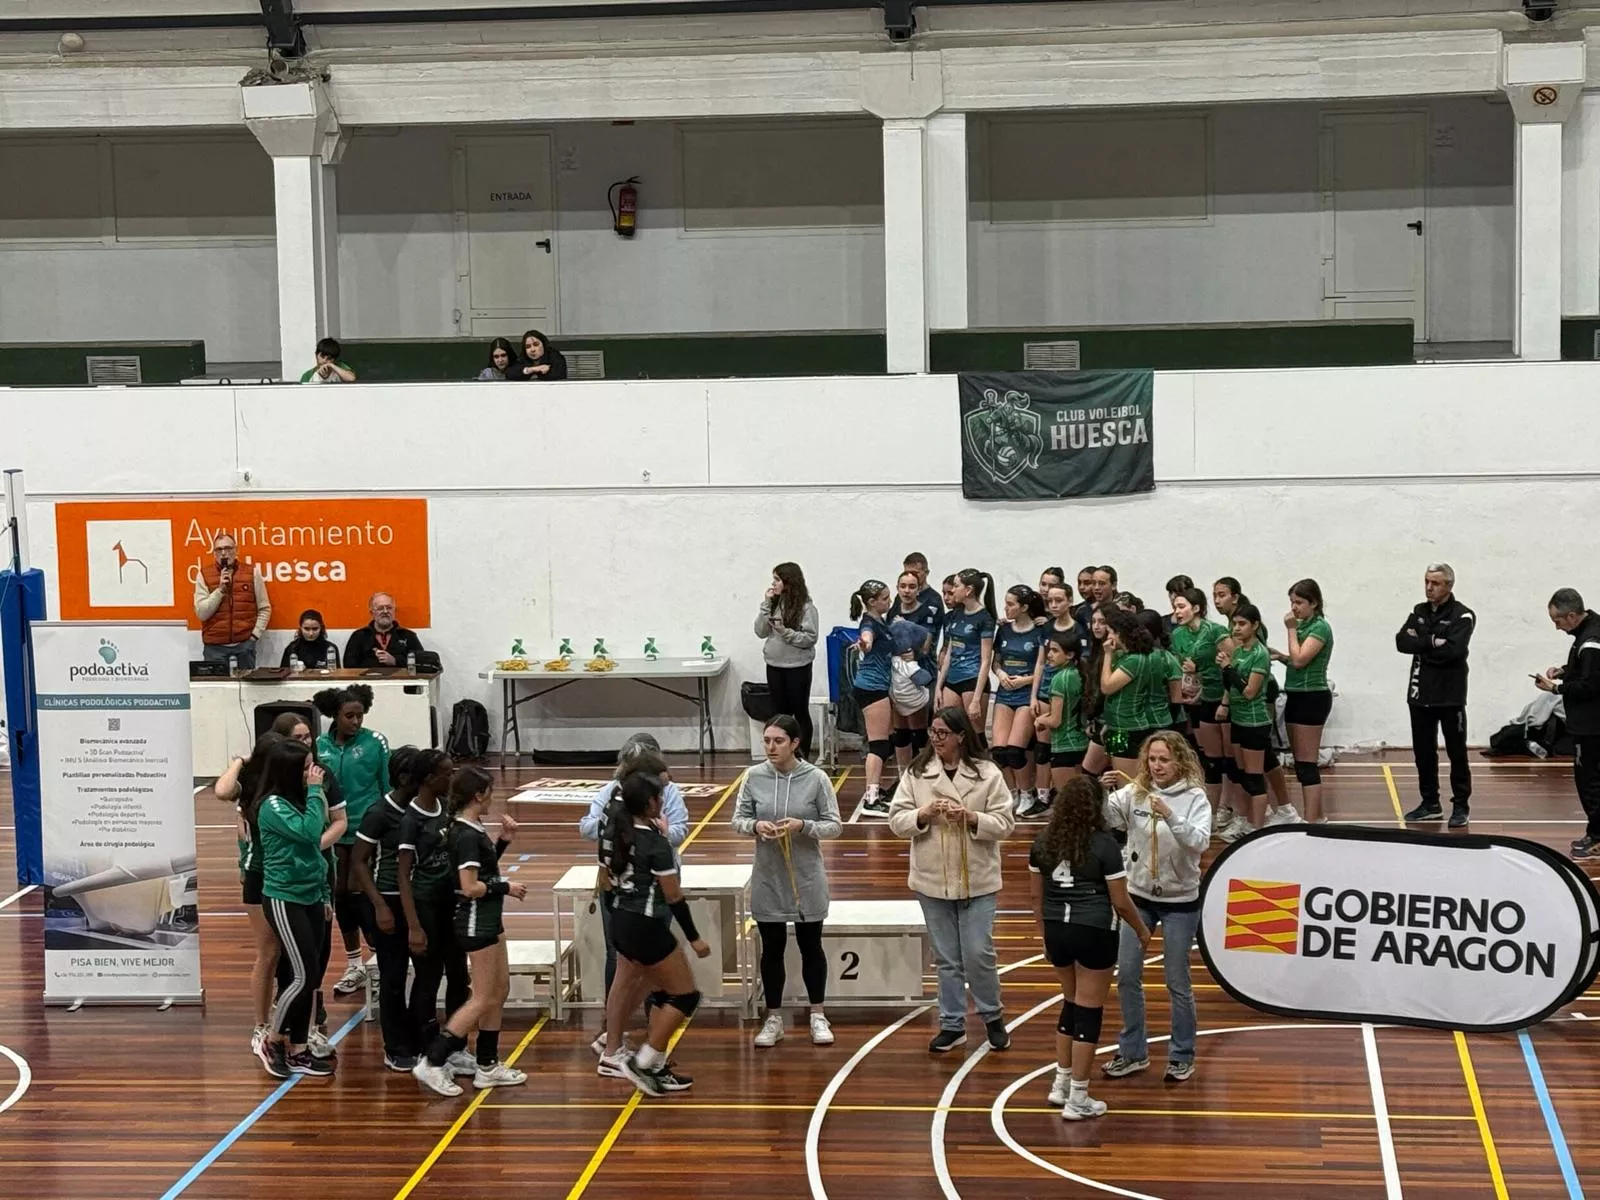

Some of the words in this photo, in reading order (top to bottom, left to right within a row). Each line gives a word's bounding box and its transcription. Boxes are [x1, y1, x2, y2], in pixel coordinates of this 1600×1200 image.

[490, 191, 533, 201] ENTRADA
[1056, 409, 1086, 423] CLUB
[1088, 404, 1142, 421] VOLEIBOL
[1050, 418, 1149, 450] HUESCA
[245, 555, 347, 582] uesca
[69, 662, 149, 682] podoactiva
[43, 697, 79, 707] CLÍNICAS
[80, 697, 132, 707] PODOLÓGICAS
[134, 697, 181, 706] PODOACTIVA
[1304, 886, 1526, 935] GOBIERNO
[70, 957, 92, 967] PISA
[94, 957, 119, 967] BIEN,
[120, 957, 140, 966] VIVE
[143, 957, 175, 966] MEJOR
[1302, 925, 1357, 960] DE
[1371, 930, 1556, 978] ARAGON
[840, 951, 860, 980] 2
